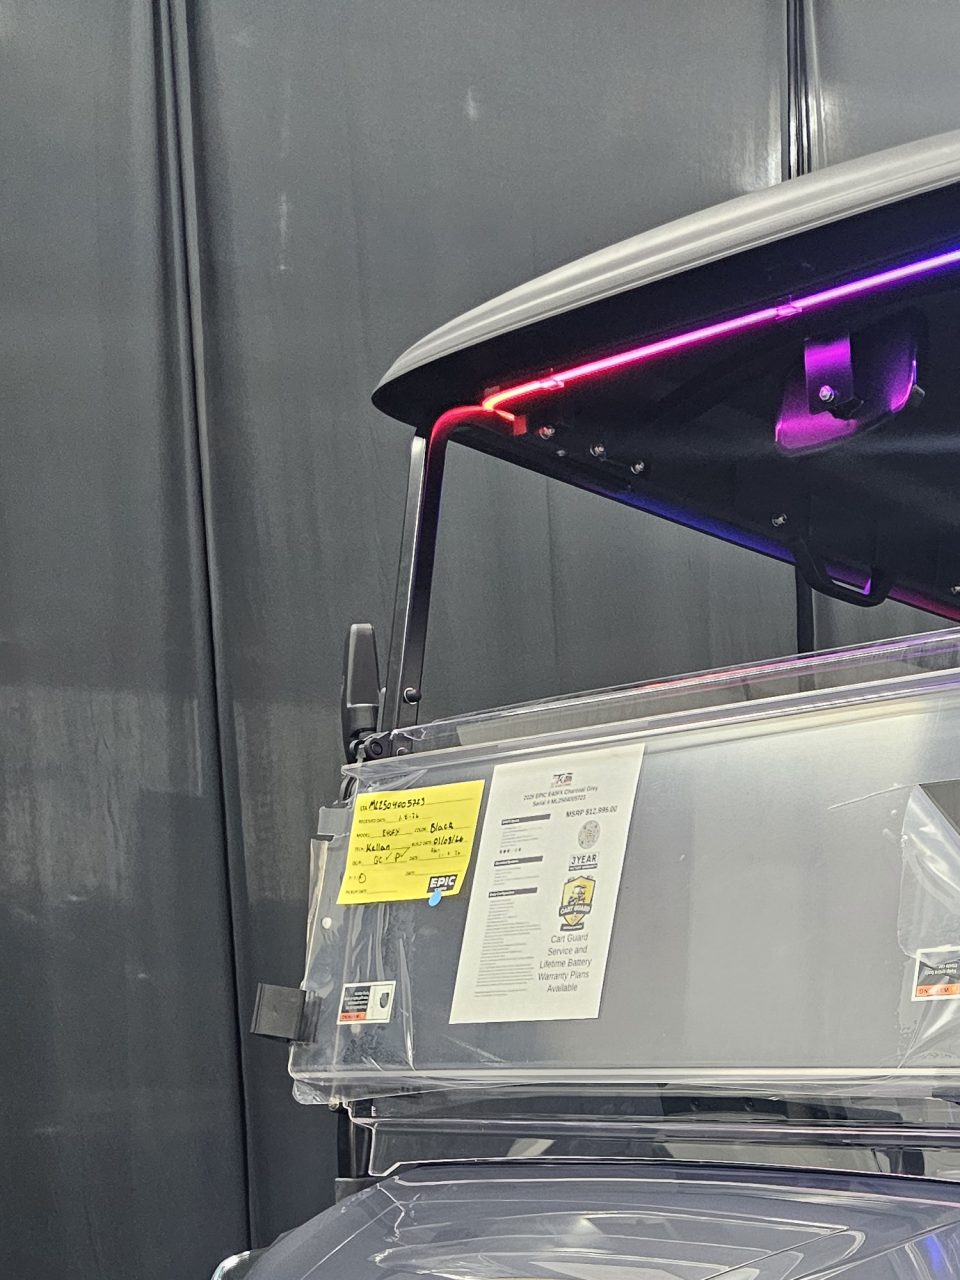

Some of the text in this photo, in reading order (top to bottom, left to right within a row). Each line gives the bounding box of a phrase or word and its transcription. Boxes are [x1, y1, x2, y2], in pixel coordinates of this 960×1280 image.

[566, 809, 585, 818] MSRP
[429, 821, 454, 834] Black
[429, 875, 457, 888] EPIC
[551, 933, 588, 943] Cart Guard
[547, 945, 588, 956] Service and
[540, 958, 592, 969] Lifetime Battery
[538, 970, 589, 982] Warranty Plans
[547, 983, 578, 992] Available
